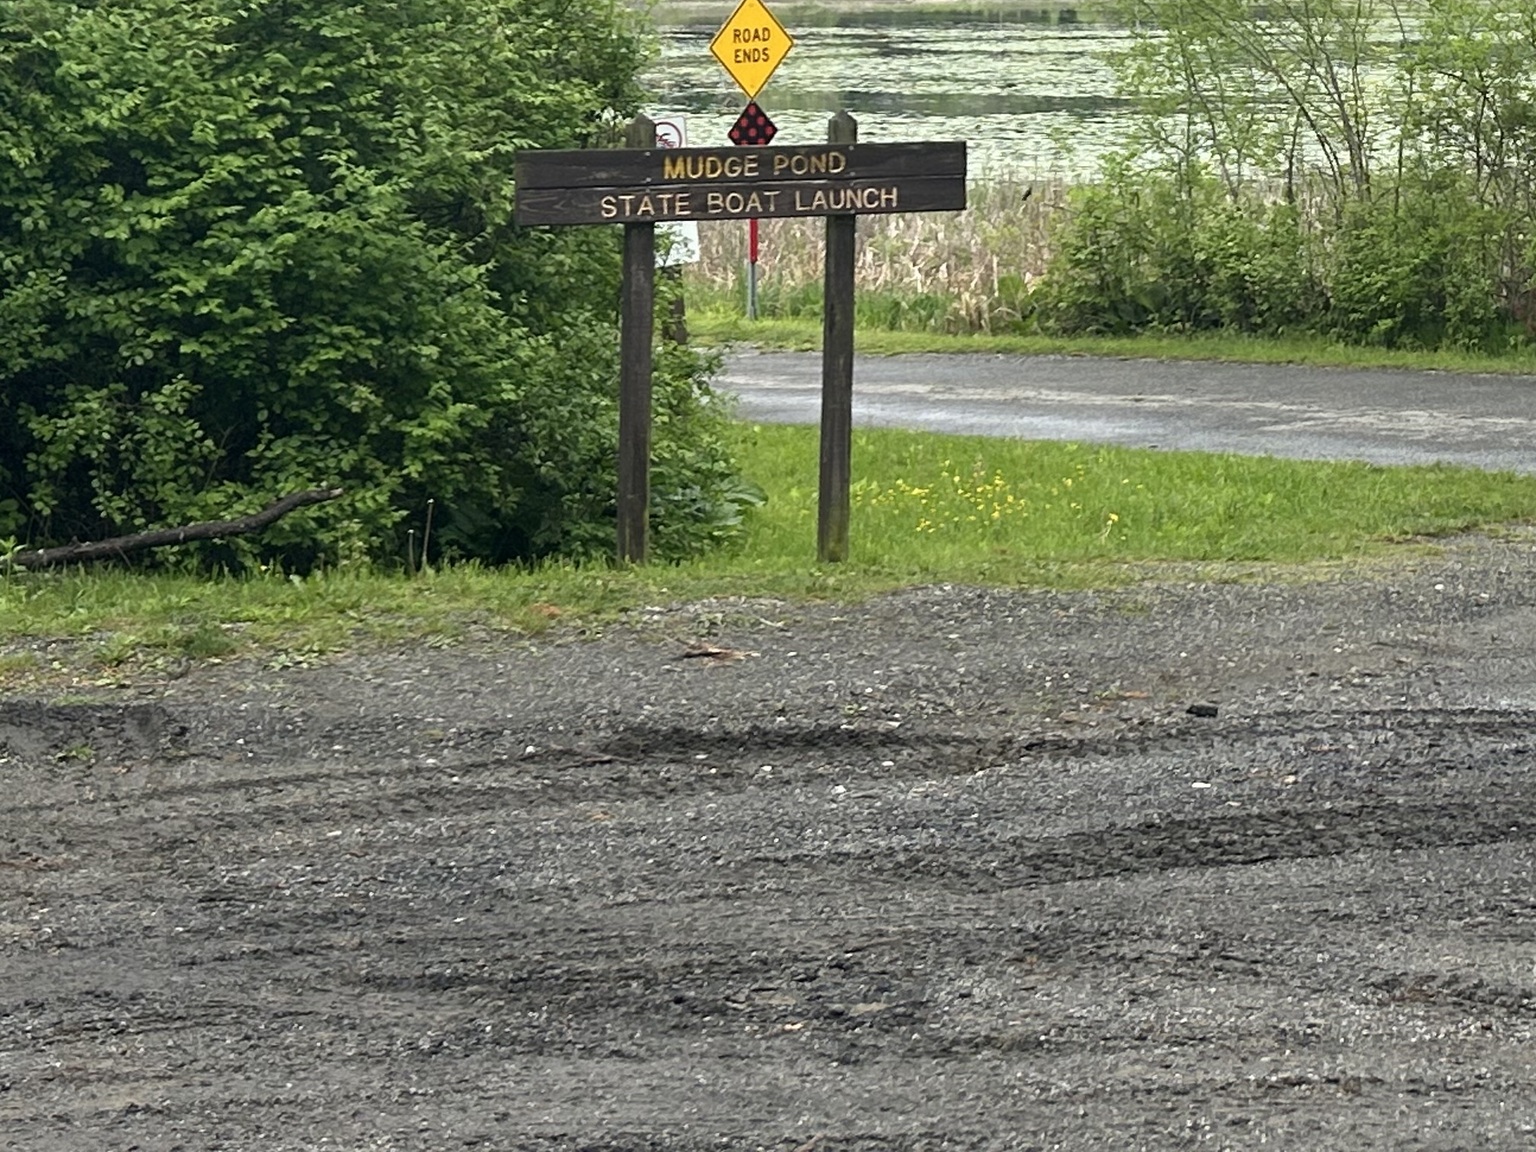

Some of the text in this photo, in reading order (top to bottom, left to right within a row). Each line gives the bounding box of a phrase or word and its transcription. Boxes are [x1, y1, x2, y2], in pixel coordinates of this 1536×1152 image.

[732, 27, 771, 44] ROAD
[733, 48, 770, 63] ENDS
[663, 151, 846, 179] MUDGE POND
[600, 187, 898, 218] STATE BOAT LAUNCH
